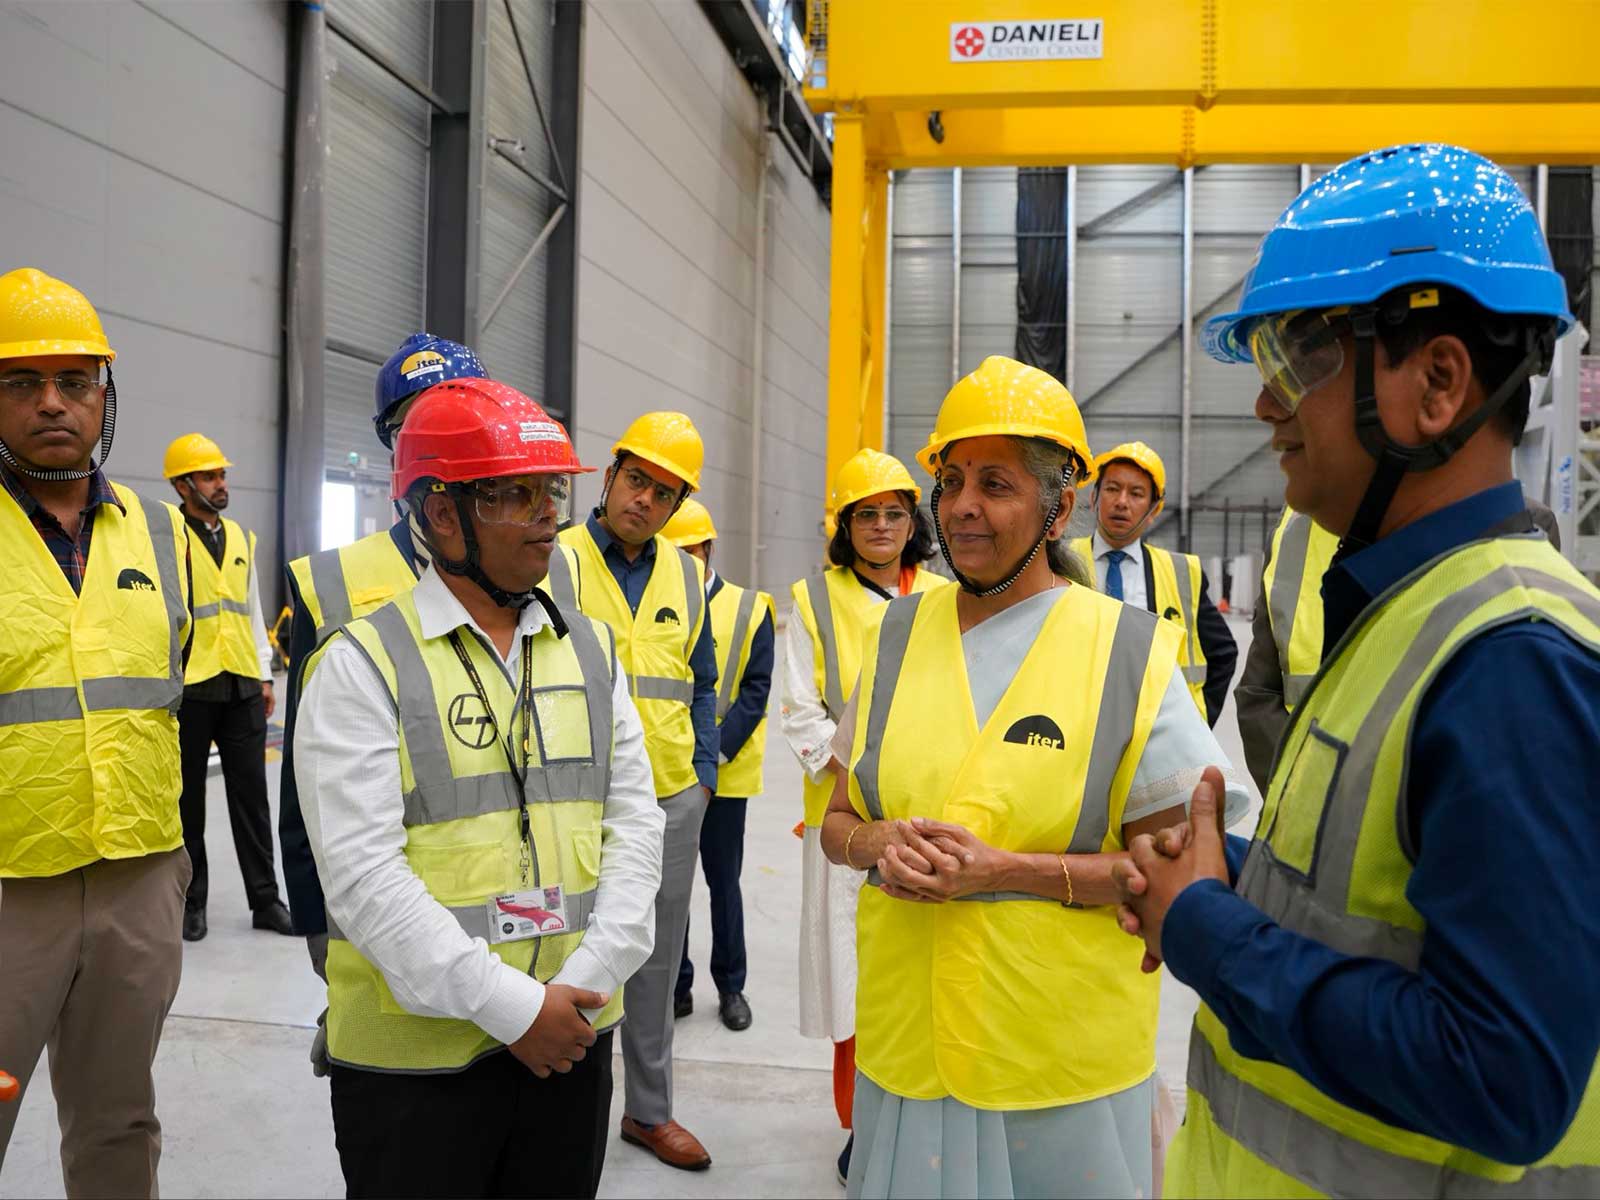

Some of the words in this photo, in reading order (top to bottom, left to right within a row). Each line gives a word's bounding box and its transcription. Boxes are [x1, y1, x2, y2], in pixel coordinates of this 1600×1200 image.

[991, 23, 1100, 43] DANIELI
[416, 357, 441, 368] iter
[130, 580, 153, 592] iter
[1026, 732, 1061, 750] iter
